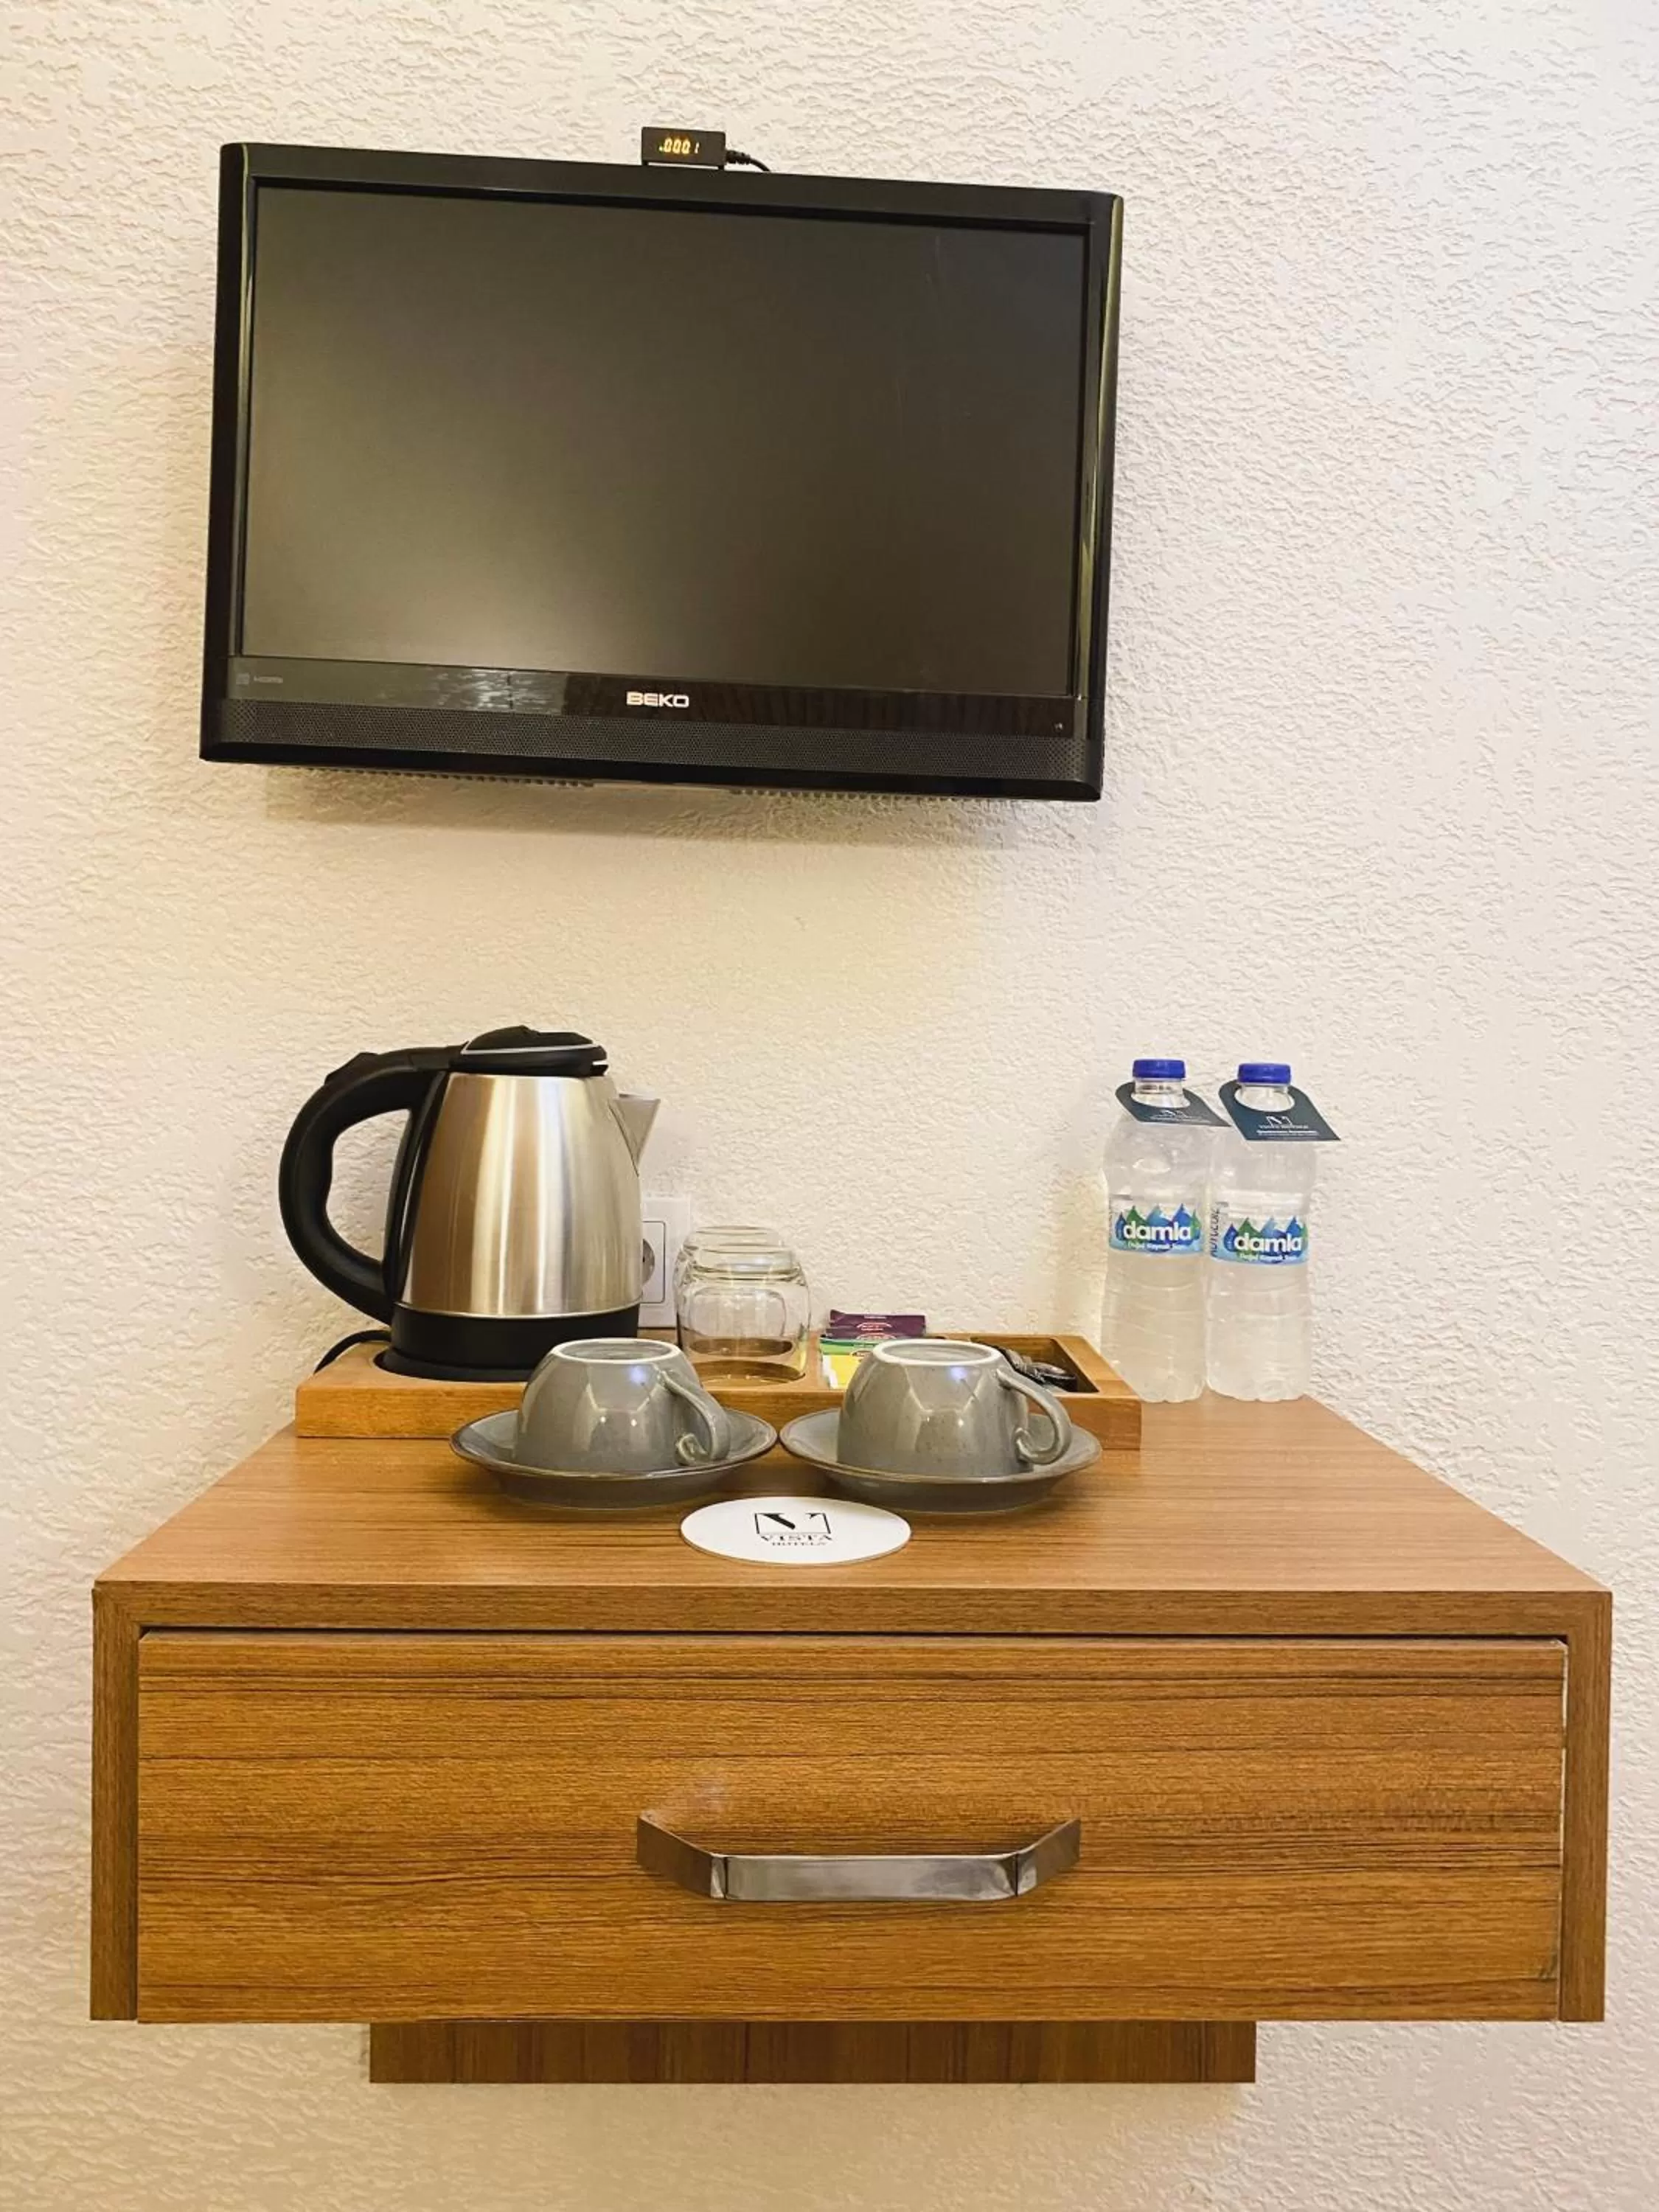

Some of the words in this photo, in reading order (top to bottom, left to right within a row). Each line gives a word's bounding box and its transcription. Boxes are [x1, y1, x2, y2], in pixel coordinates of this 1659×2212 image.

[626, 691, 689, 708] BEKO
[1123, 1220, 1192, 1241] damla
[1234, 1232, 1301, 1253] damla
